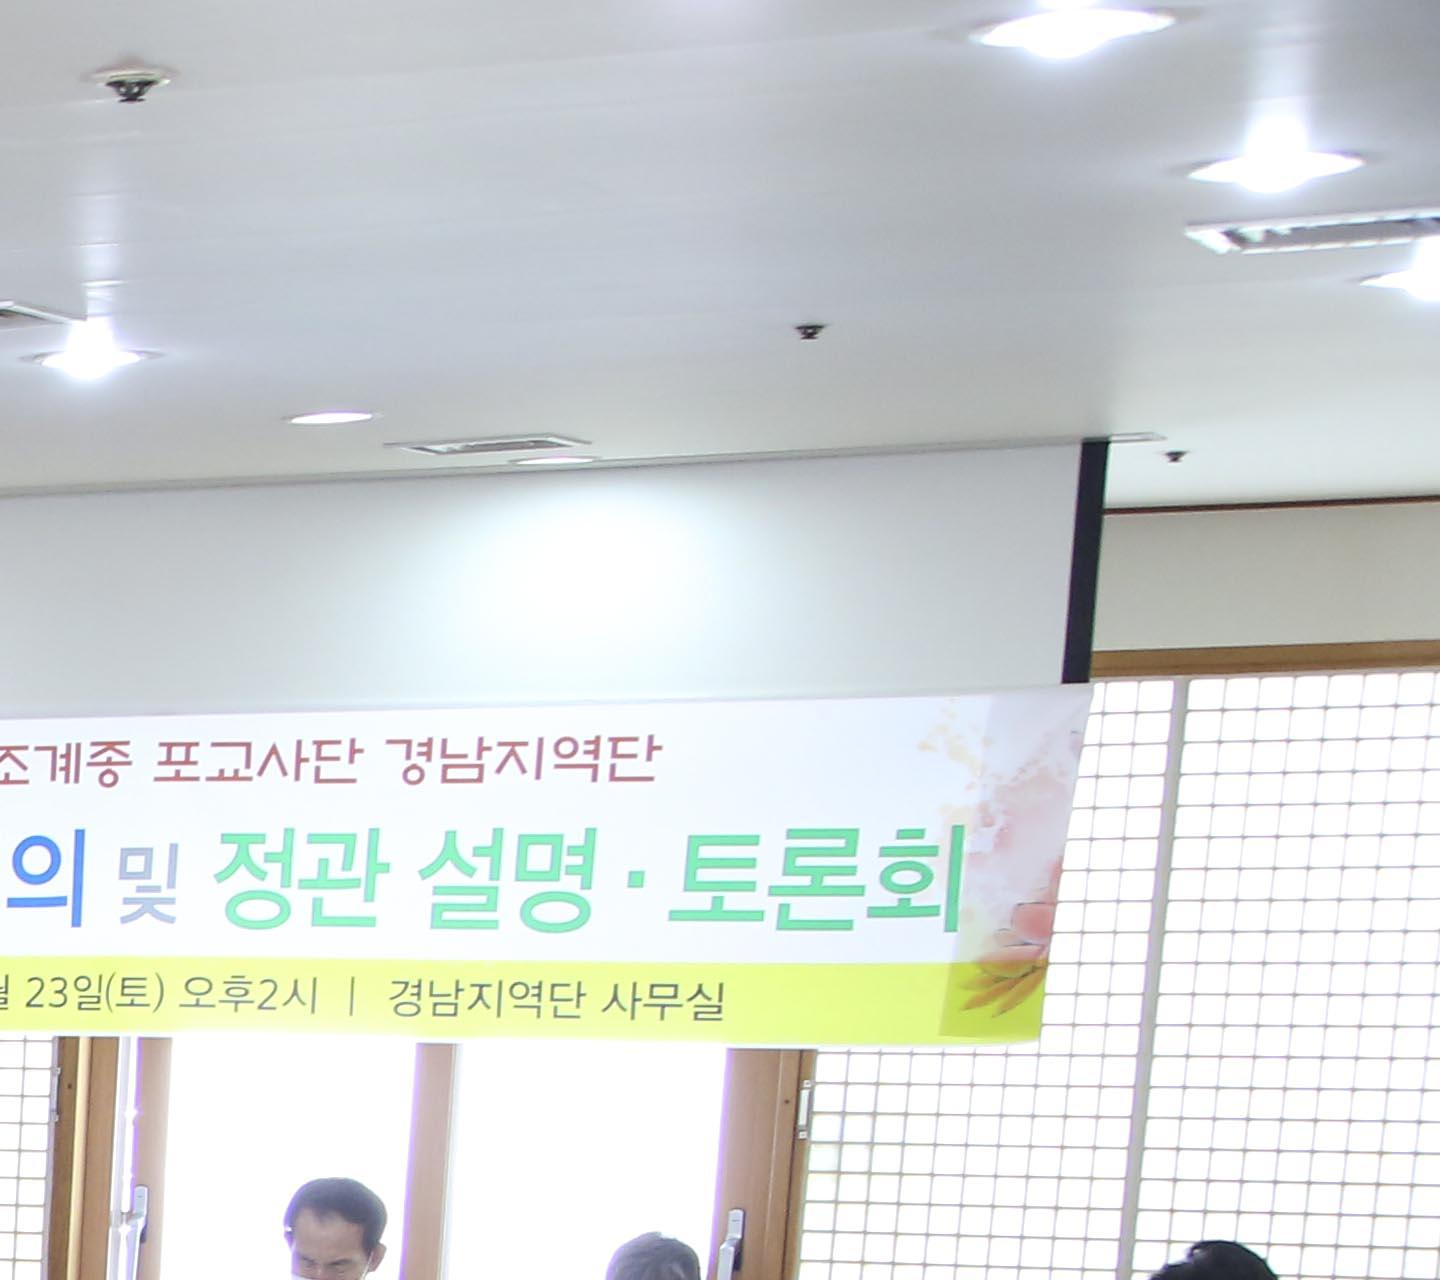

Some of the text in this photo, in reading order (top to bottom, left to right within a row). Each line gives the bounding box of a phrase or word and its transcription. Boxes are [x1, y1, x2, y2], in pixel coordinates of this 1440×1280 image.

[154, 737, 364, 786] 포교사단
[385, 735, 662, 786] 경남지역단
[118, 843, 178, 925] 및
[214, 826, 390, 931] 정관
[26, 971, 164, 1014] 23일(토)
[179, 975, 317, 1014] 오후2시
[389, 979, 587, 1020] 경남지역단
[601, 981, 725, 1022] 사무실
